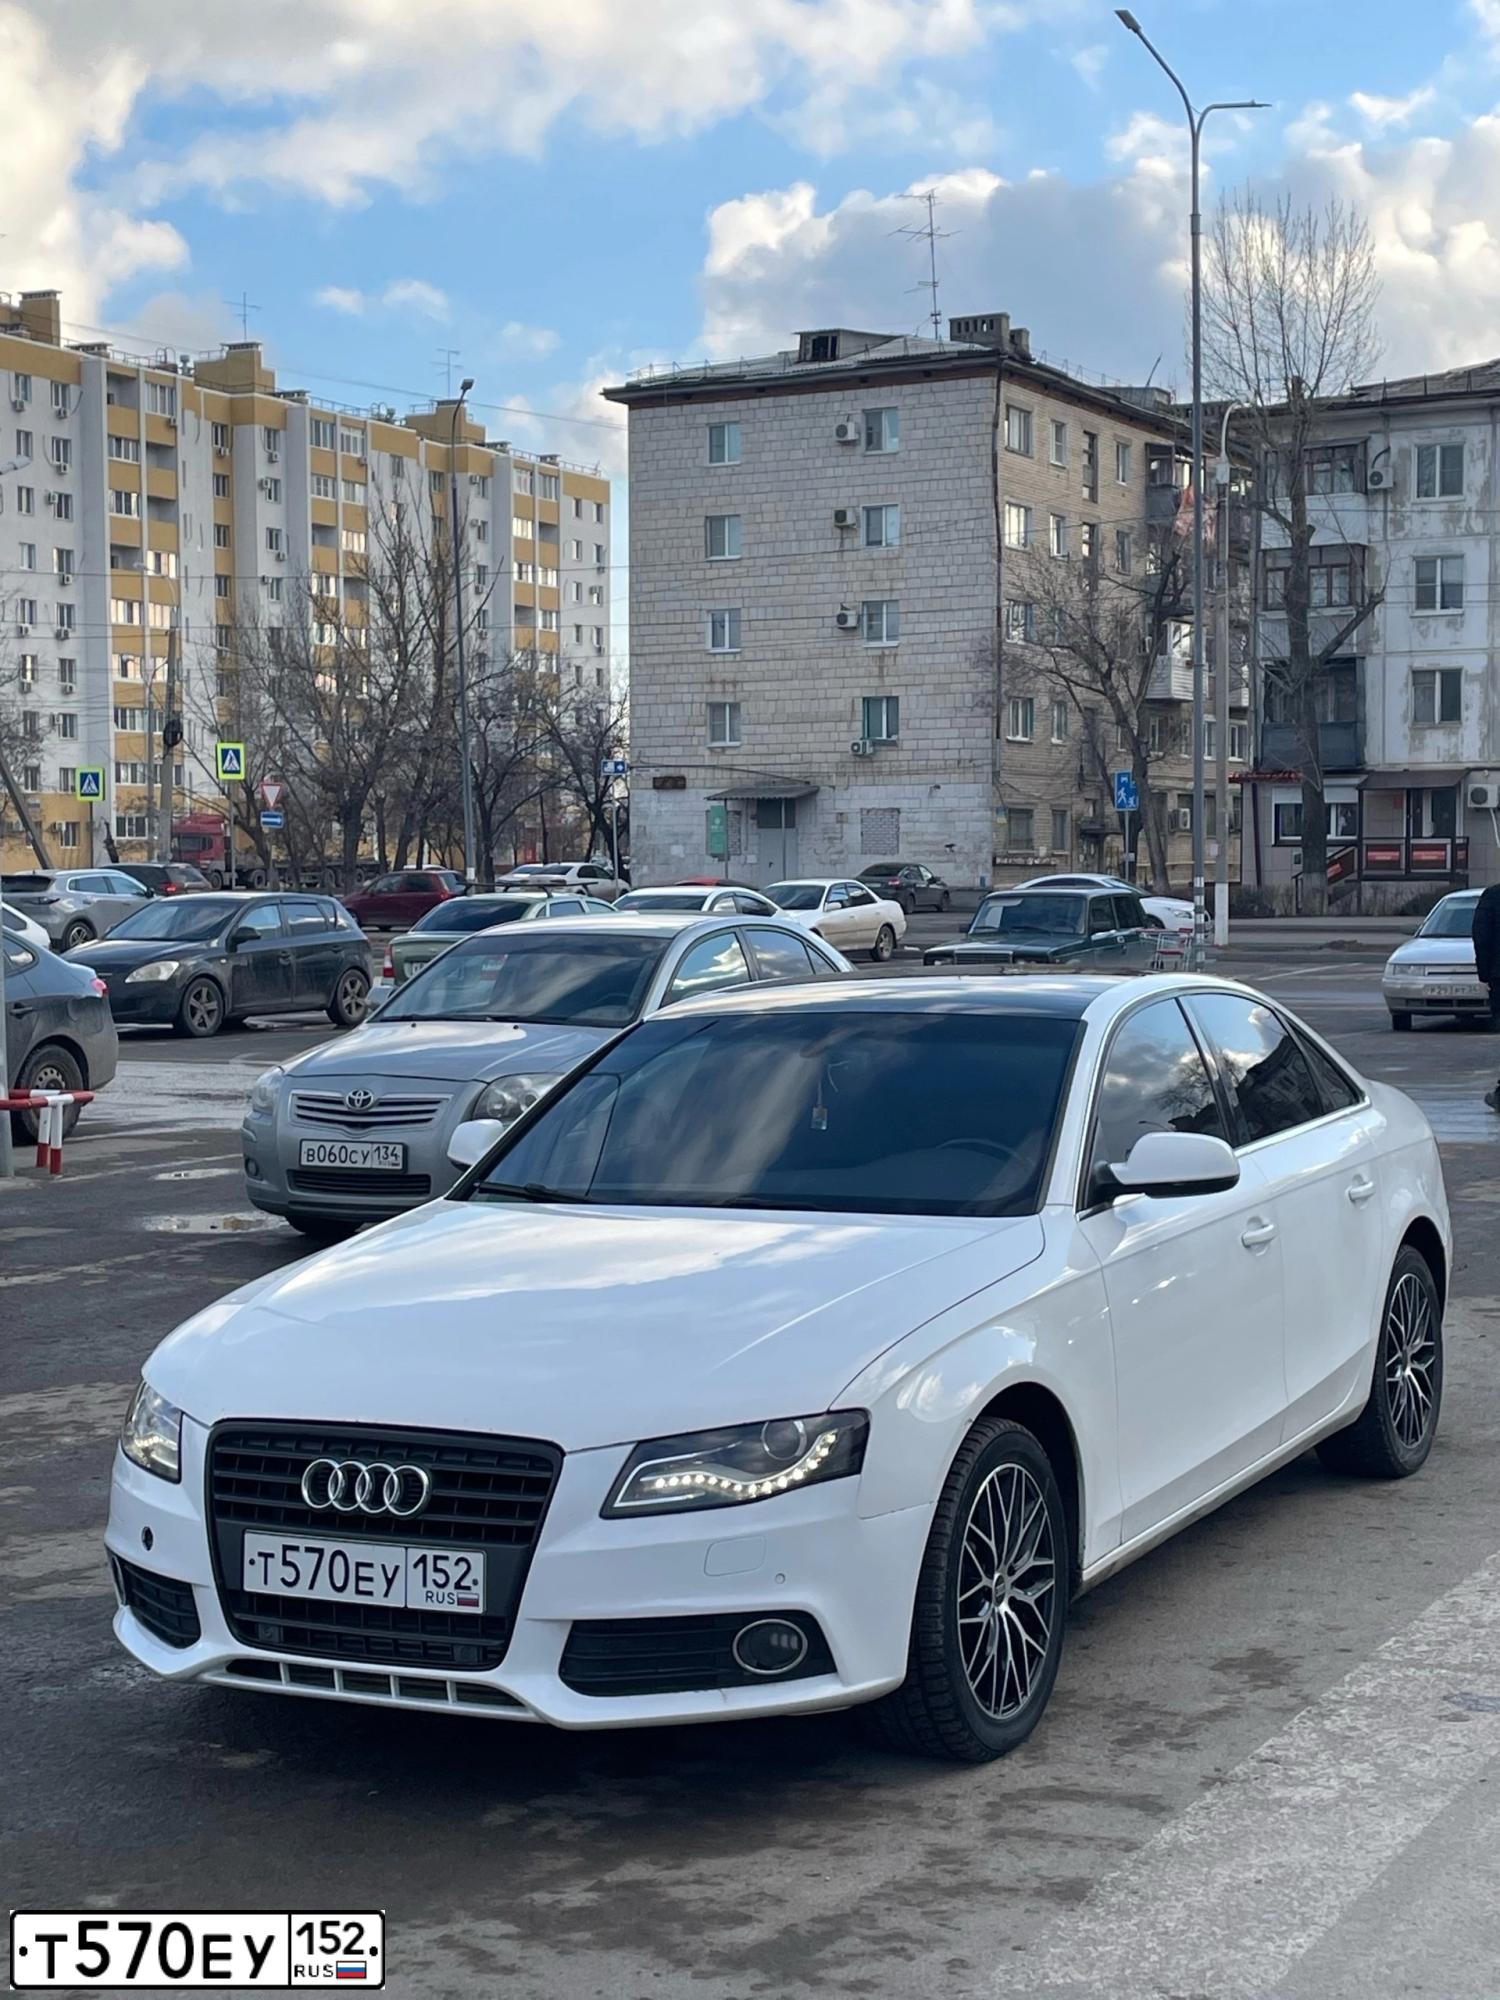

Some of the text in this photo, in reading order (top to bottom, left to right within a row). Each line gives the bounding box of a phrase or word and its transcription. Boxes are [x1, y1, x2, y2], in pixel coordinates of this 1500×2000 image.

[306, 1144, 399, 1165] В060СУ 134
[257, 1543, 472, 1598] Т570ЕУ 152
[425, 1590, 455, 1605] RUS
